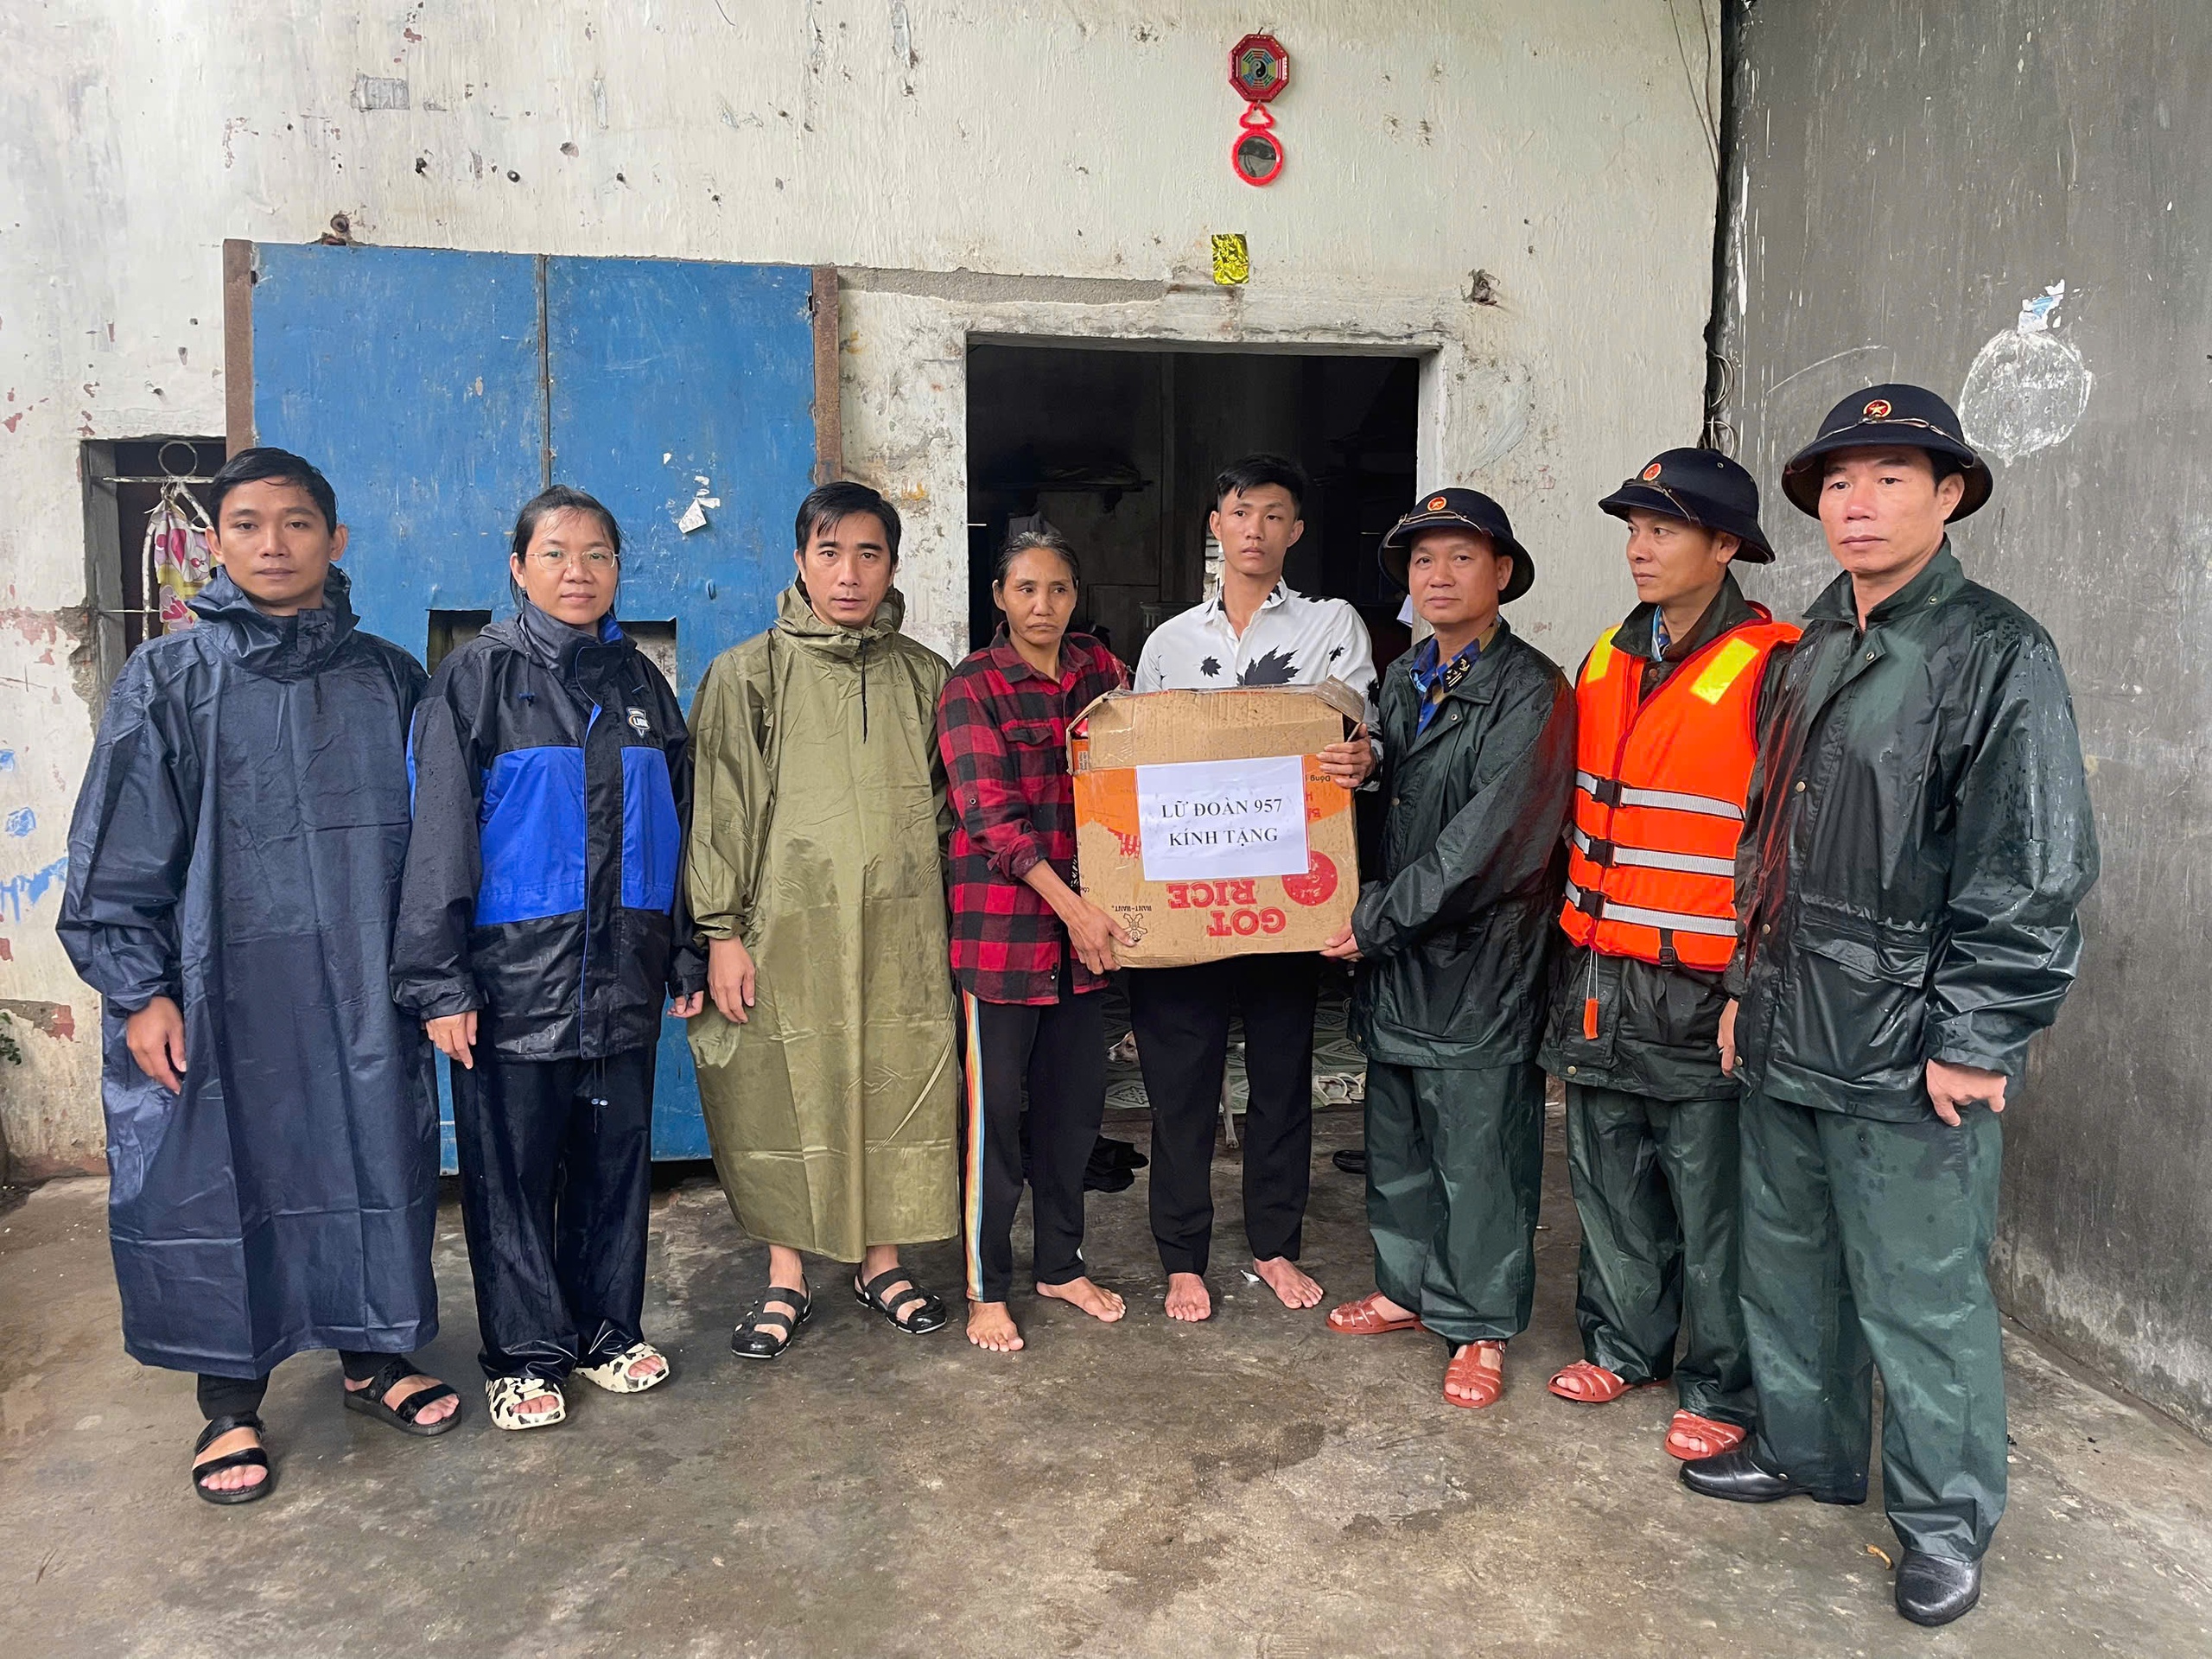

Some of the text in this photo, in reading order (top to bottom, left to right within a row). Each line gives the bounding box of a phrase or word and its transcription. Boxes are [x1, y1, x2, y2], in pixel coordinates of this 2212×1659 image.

[1161, 797, 1282, 818] LỮ ĐOÀN 957
[1169, 827, 1278, 847] KÍNH TẶNG
[1166, 879, 1257, 909] RICE
[1206, 906, 1287, 937] GOT
